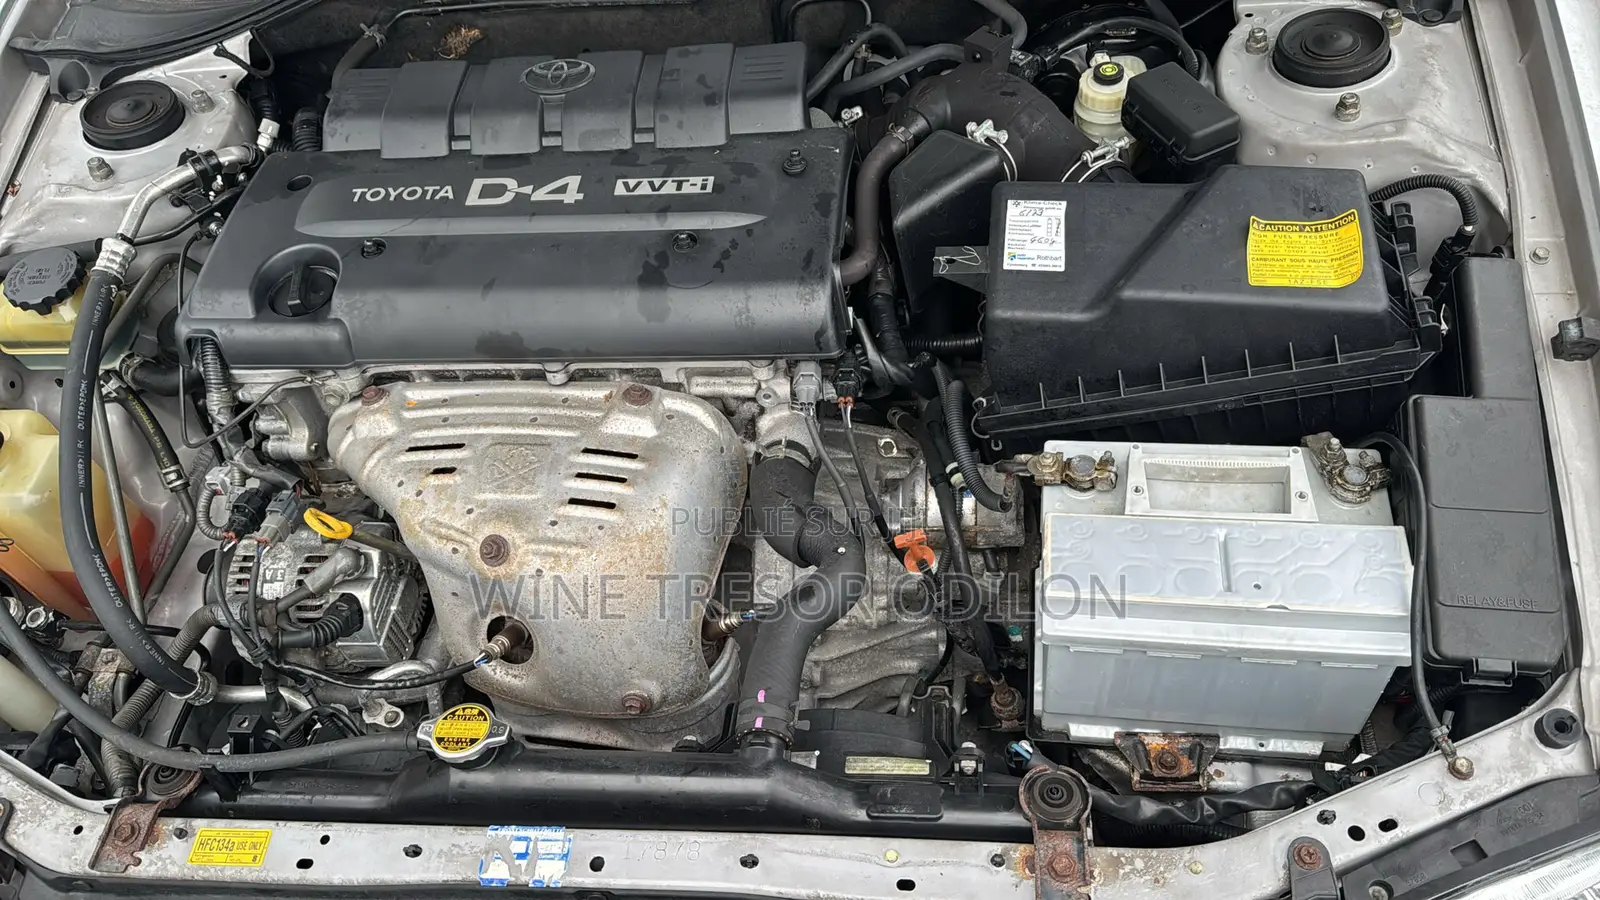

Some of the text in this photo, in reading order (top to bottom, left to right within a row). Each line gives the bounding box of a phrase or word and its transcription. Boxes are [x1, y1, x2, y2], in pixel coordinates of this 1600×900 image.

[351, 175, 711, 206] TOYOTA D-4 VVT-i
[1259, 214, 1355, 232] CAUTION ATTENTION
[446, 714, 485, 722] CAUTION
[197, 838, 264, 852] HFC134a USE ONLY
